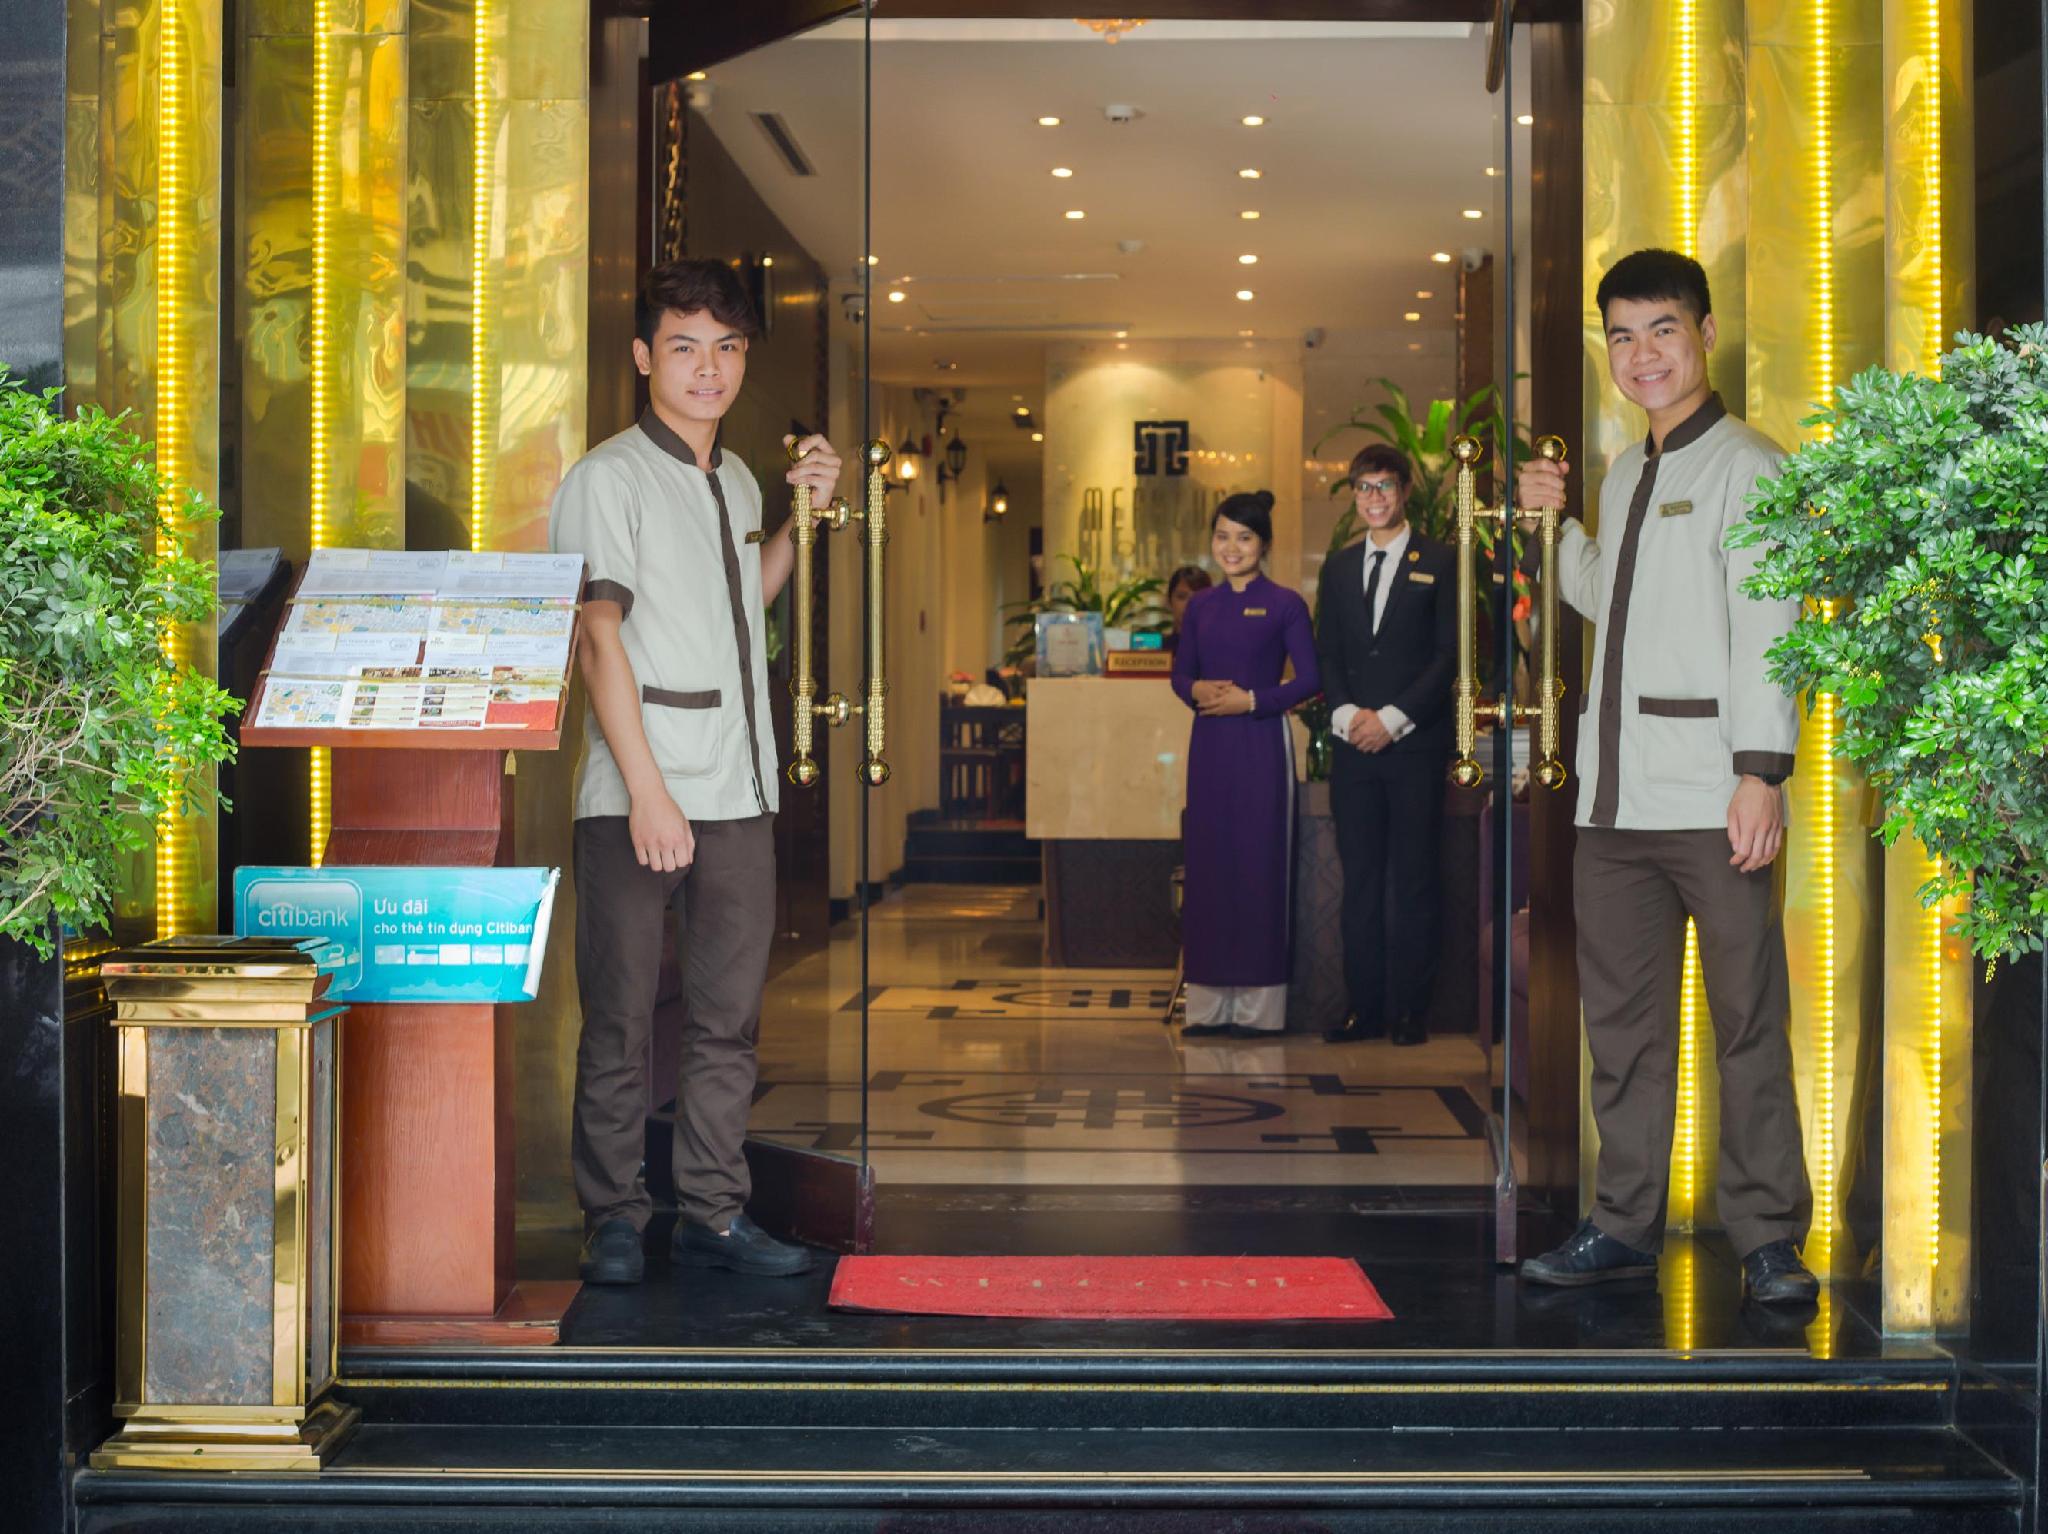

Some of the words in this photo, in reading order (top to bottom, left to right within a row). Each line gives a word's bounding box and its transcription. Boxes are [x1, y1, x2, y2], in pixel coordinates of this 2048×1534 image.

[258, 901, 349, 927] citibank
[374, 922, 398, 935] cho
[486, 921, 533, 935] Citiban
